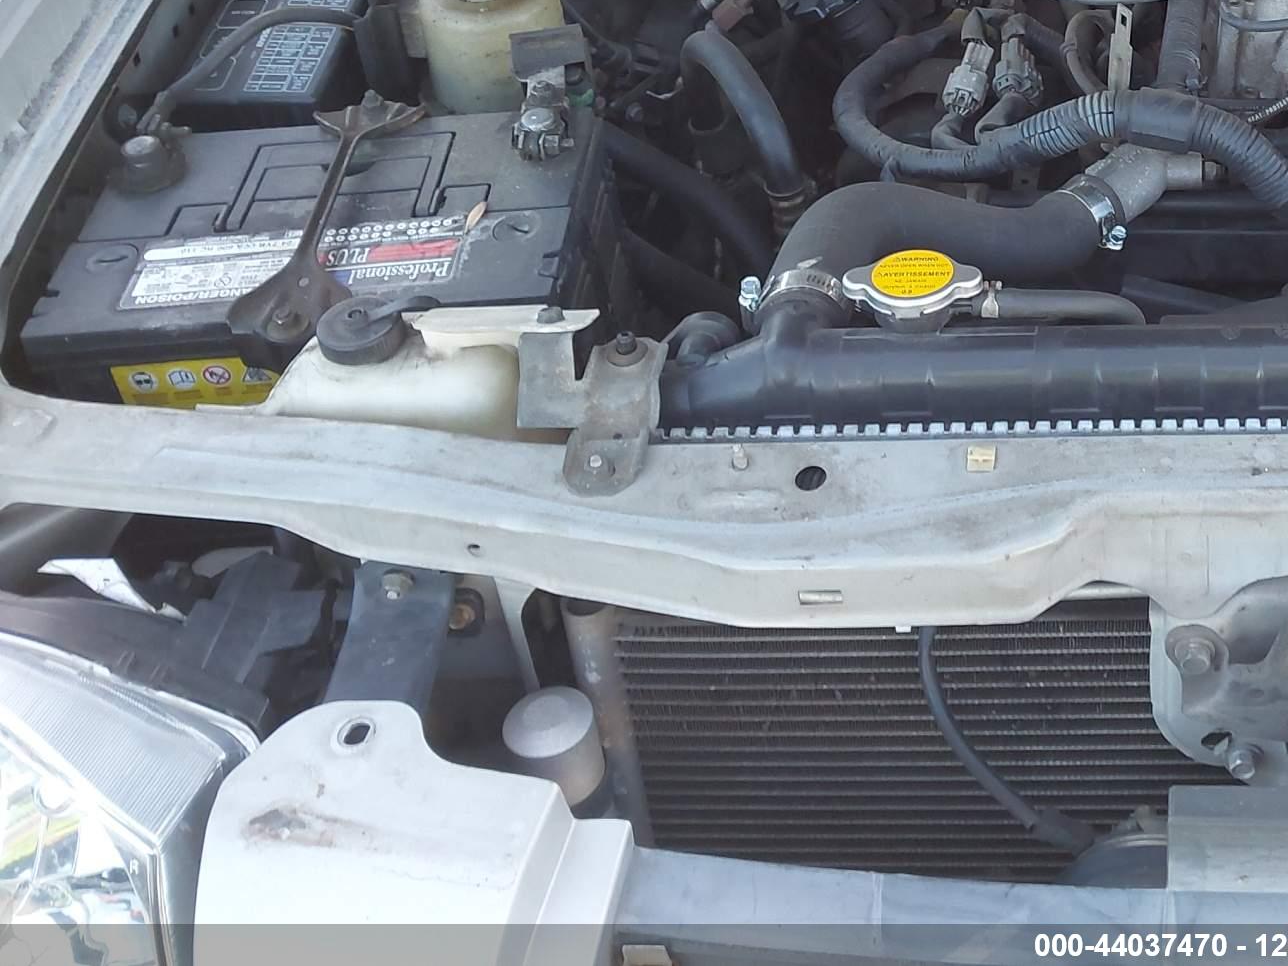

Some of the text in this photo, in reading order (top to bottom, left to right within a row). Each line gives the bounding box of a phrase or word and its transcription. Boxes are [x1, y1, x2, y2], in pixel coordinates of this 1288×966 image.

[326, 247, 371, 266] PLUS
[347, 261, 451, 285] Professional
[883, 270, 950, 278] AVERTISSEMENT
[134, 287, 252, 305] ANGER/POISON
